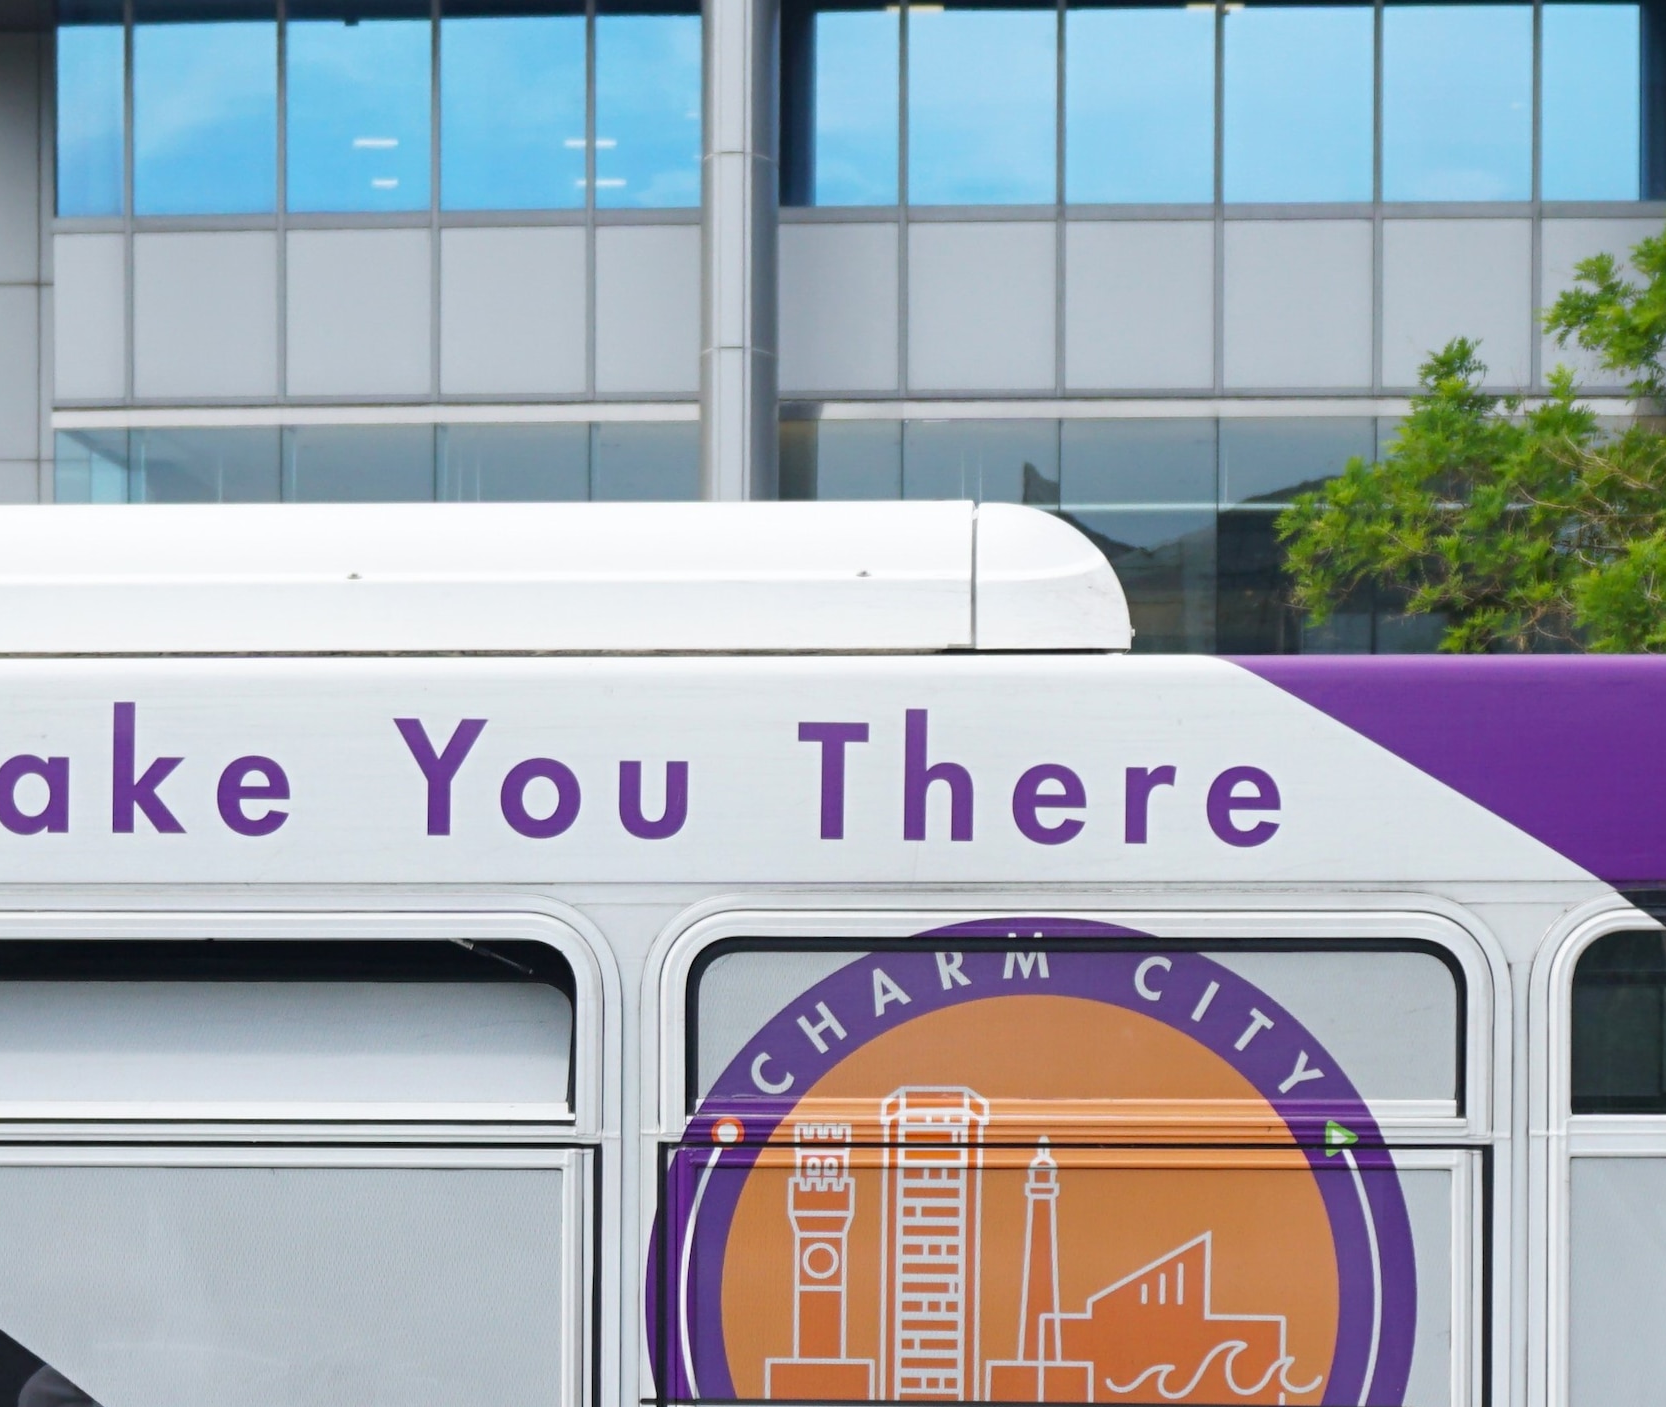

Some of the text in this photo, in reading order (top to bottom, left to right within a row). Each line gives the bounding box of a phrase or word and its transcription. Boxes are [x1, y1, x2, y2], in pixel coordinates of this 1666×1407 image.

[393, 718, 689, 841] You
[797, 708, 1282, 848] There
[750, 931, 1326, 1096] CHARM CITY
